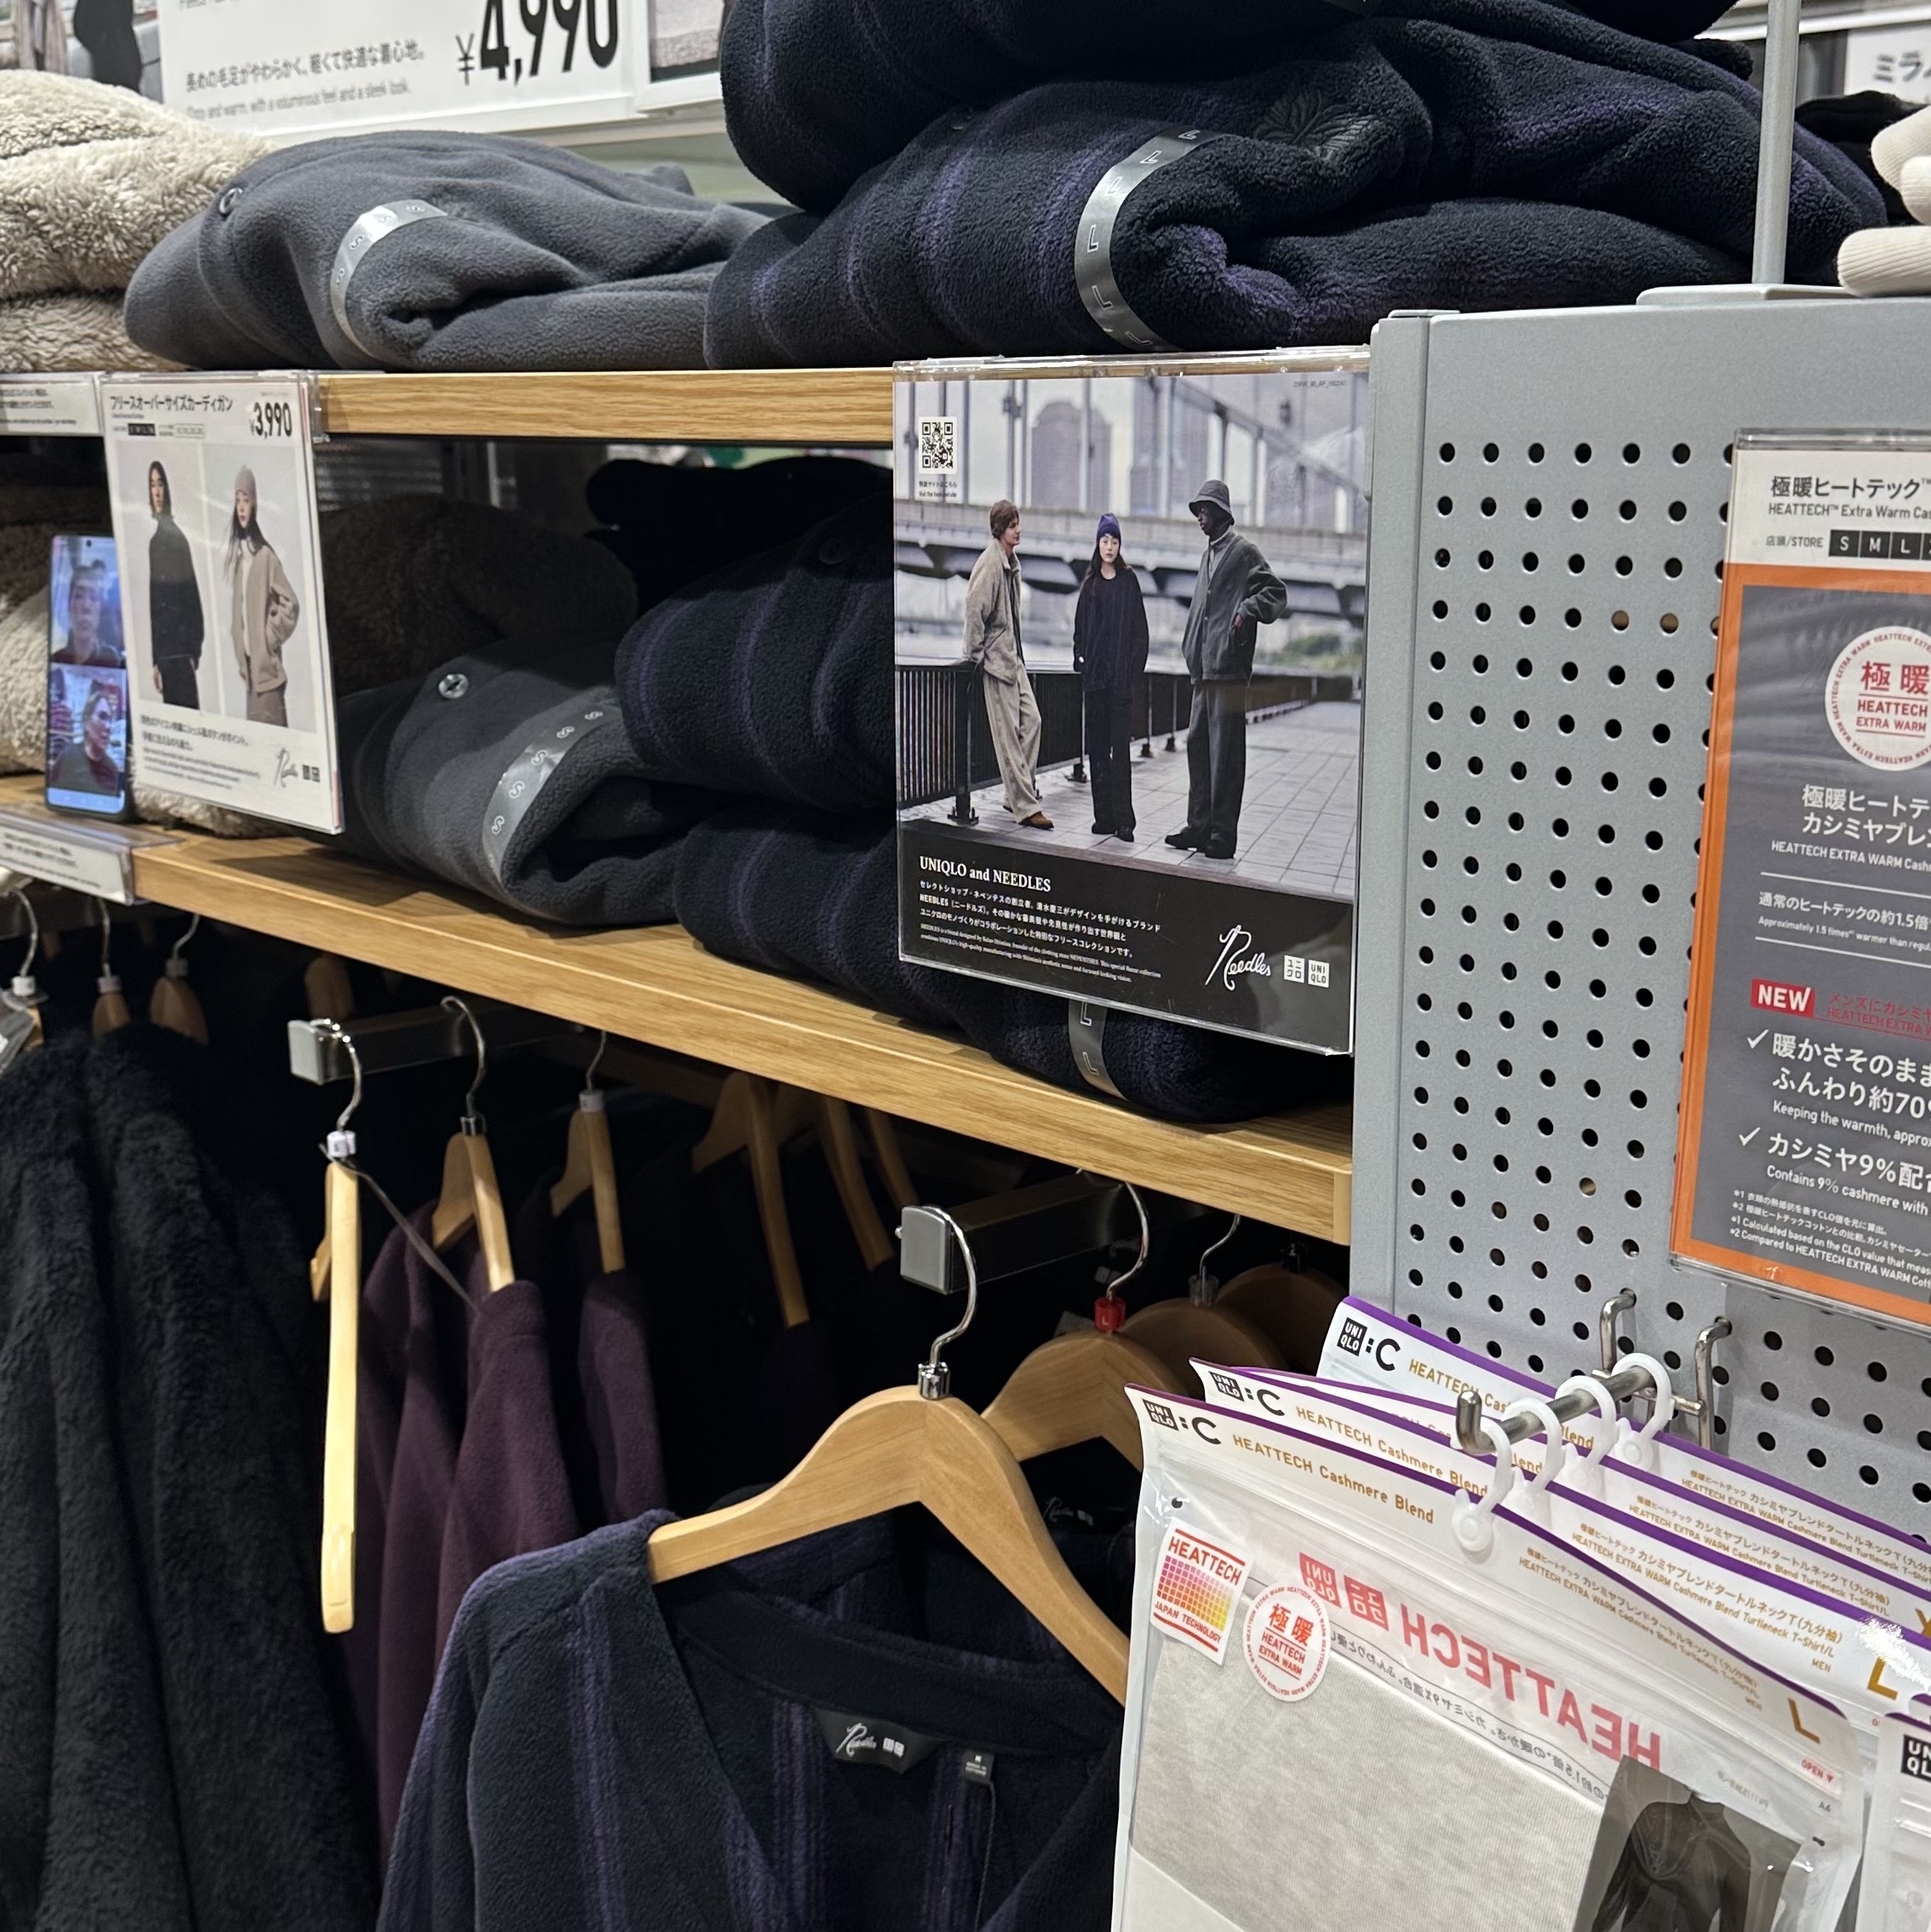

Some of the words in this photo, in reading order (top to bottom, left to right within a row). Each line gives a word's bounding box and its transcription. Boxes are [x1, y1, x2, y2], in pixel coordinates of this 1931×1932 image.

[1841, 505, 1872, 518] Extra
[1876, 506, 1911, 519] Warm
[1860, 660, 1929, 696] 極暖
[1856, 716, 1889, 729] EXTRA
[1894, 719, 1926, 733] WARM
[1857, 699, 1928, 717] HEATTECH
[1771, 840, 1827, 858] HEATTECH
[1829, 847, 1865, 863] EXTRA
[1868, 853, 1902, 869] WARM
[920, 855, 967, 877] UNIQLO
[969, 868, 990, 882] and
[993, 869, 1052, 892] NEEDLES
[1759, 915, 1814, 935] Approximately
[1816, 924, 1827, 934] 1.5
[1856, 932, 1888, 944] warmer
[1889, 937, 1908, 948] than
[1310, 963, 1326, 974] UNI
[1310, 973, 1327, 984] QLO
[1758, 984, 1811, 1012] NEW
[1773, 1067, 1931, 1119] ふんわり約70
[1773, 1099, 1817, 1124] Keeping
[1820, 1109, 1839, 1127] the
[1841, 1117, 1891, 1139] warmth,
[1767, 1165, 1814, 1189] Contains
[1817, 1176, 1839, 1194] 9%
[1842, 1184, 1899, 1209] cashmere
[1902, 1199, 1928, 1216] with
[1741, 1230, 1785, 1250] Compared
[1785, 1241, 1795, 1253] to
[1796, 1243, 1845, 1266] HEATTECH
[1846, 1258, 1879, 1276] EXTRA
[1880, 1266, 1911, 1284] WARM
[1742, 1217, 1787, 1237] Calculated
[1788, 1229, 1814, 1244] based
[1814, 1238, 1825, 1247] on
[1826, 1240, 1840, 1251] the
[1842, 1243, 1861, 1257] CLO
[1862, 1251, 1886, 1264] value
[1887, 1255, 1905, 1269] that
[1340, 1333, 1361, 1355] QLO
[1345, 1321, 1363, 1341] UNI
[1213, 1373, 1236, 1390] UNI
[1217, 1383, 1241, 1399] QLO
[1408, 1358, 1480, 1396] HEATTECH
[1146, 1401, 1169, 1419] UNI
[1149, 1411, 1175, 1428] QLO
[1296, 1406, 1372, 1448] HEATTECH
[1378, 1439, 1443, 1478] Cashmere
[1449, 1470, 1488, 1499] Blend
[1233, 1433, 1313, 1474] HEATTECH
[1320, 1465, 1388, 1504] Cashmere
[1395, 1493, 1435, 1524] Blend
[1682, 1478, 1725, 1501] HEATTECH
[1728, 1496, 1755, 1513] EXTRA
[1758, 1509, 1785, 1525] WARM
[1630, 1505, 1671, 1528] HEATTECH
[1674, 1523, 1700, 1541] EXTRA
[1703, 1534, 1730, 1552] WARM
[1168, 1535, 1243, 1586] HEATTECH
[1519, 1556, 1561, 1585] HEATTECH
[1563, 1579, 1590, 1599] EXTRA
[1573, 1533, 1614, 1560] HEATTECH
[1616, 1554, 1642, 1574] EXTRA
[1645, 1568, 1671, 1587] WARM
[1673, 1581, 1712, 1607] Cashmere
[1715, 1601, 1740, 1619] Blend
[1744, 1612, 1789, 1639] Turtleneck
[1154, 1600, 1180, 1620] JAPAN
[1181, 1613, 1223, 1645] TECHNOLOGY
[1269, 1603, 1314, 1647] 極暖
[1258, 1644, 1280, 1664] EXTRA
[1282, 1658, 1303, 1676] WARM
[1262, 1631, 1306, 1665] HEATTECH
[1787, 1697, 1820, 1744] L
[1801, 1758, 1824, 1780] OPEN
